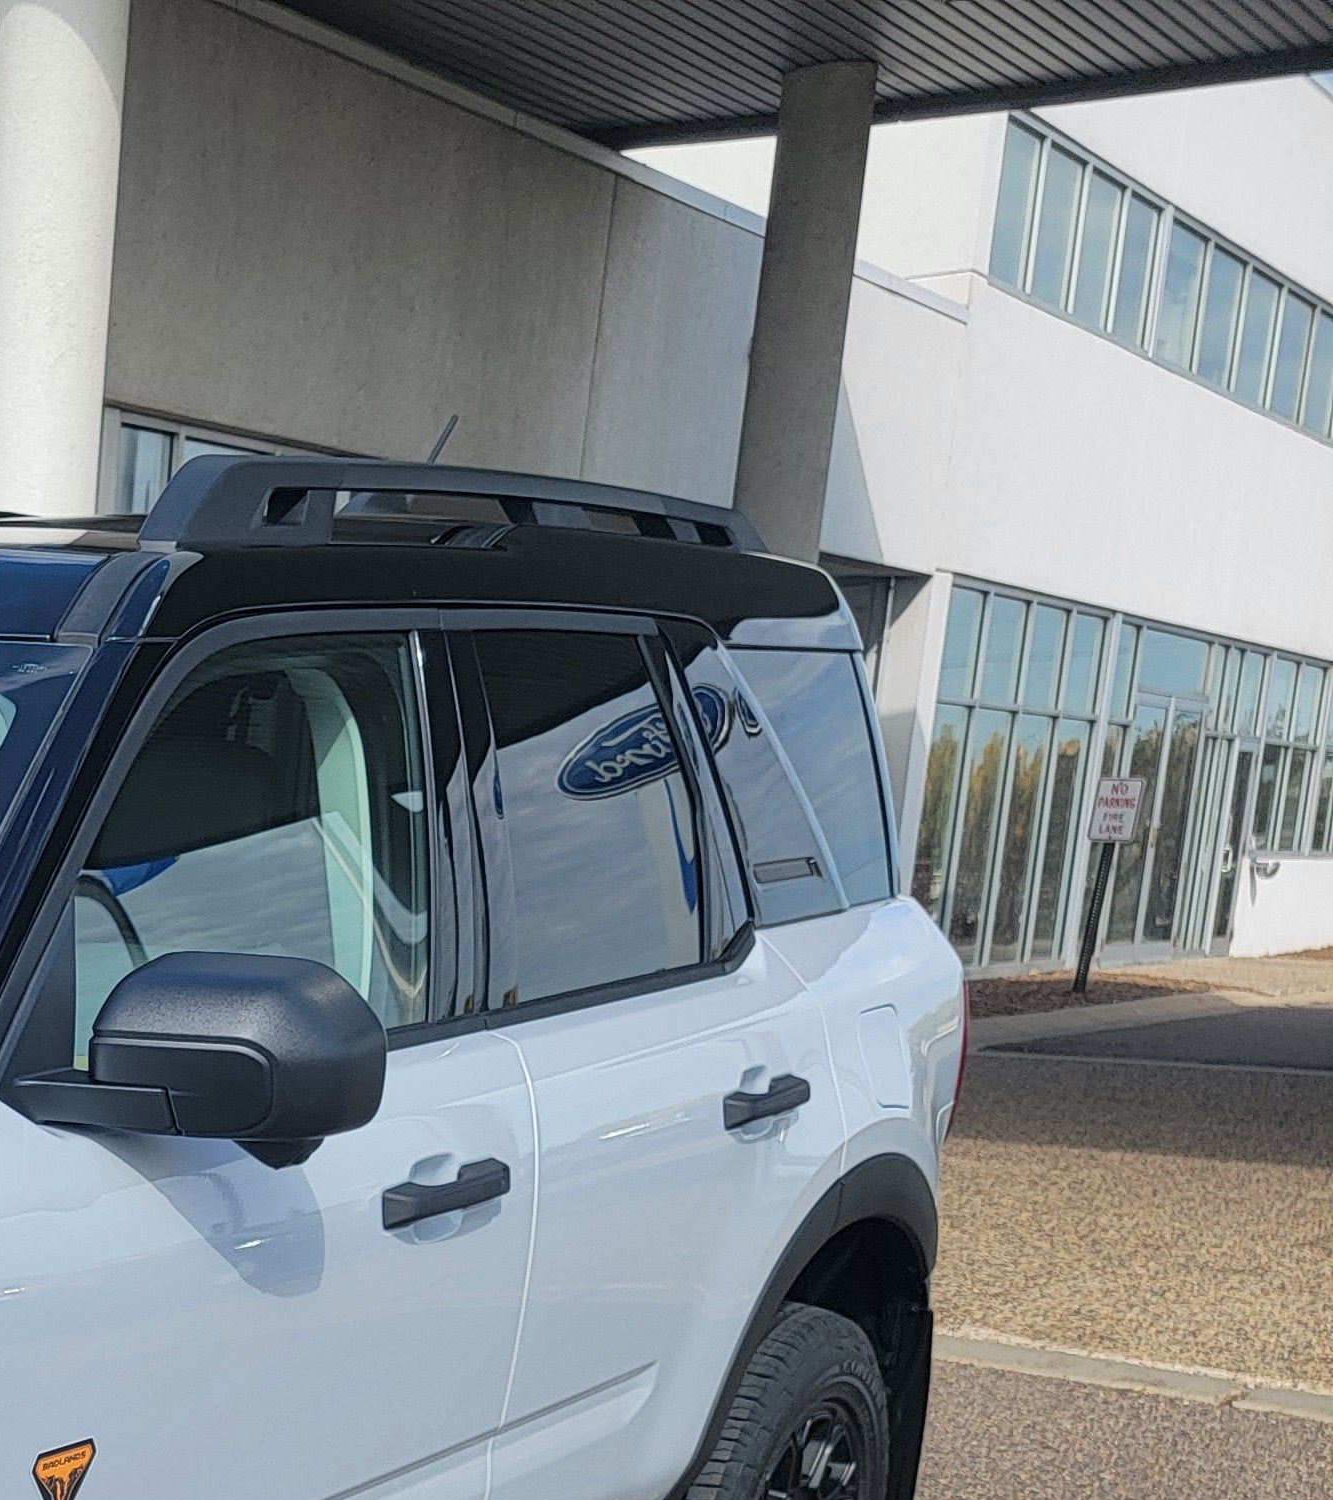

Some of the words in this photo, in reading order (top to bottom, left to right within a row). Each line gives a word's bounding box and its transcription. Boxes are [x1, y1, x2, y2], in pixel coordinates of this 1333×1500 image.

[1111, 783, 1129, 796] NO
[1098, 797, 1136, 809] PARKING
[1102, 813, 1125, 823] FIRE
[1099, 824, 1125, 835] LANE
[42, 1451, 86, 1471] BADLANDS
